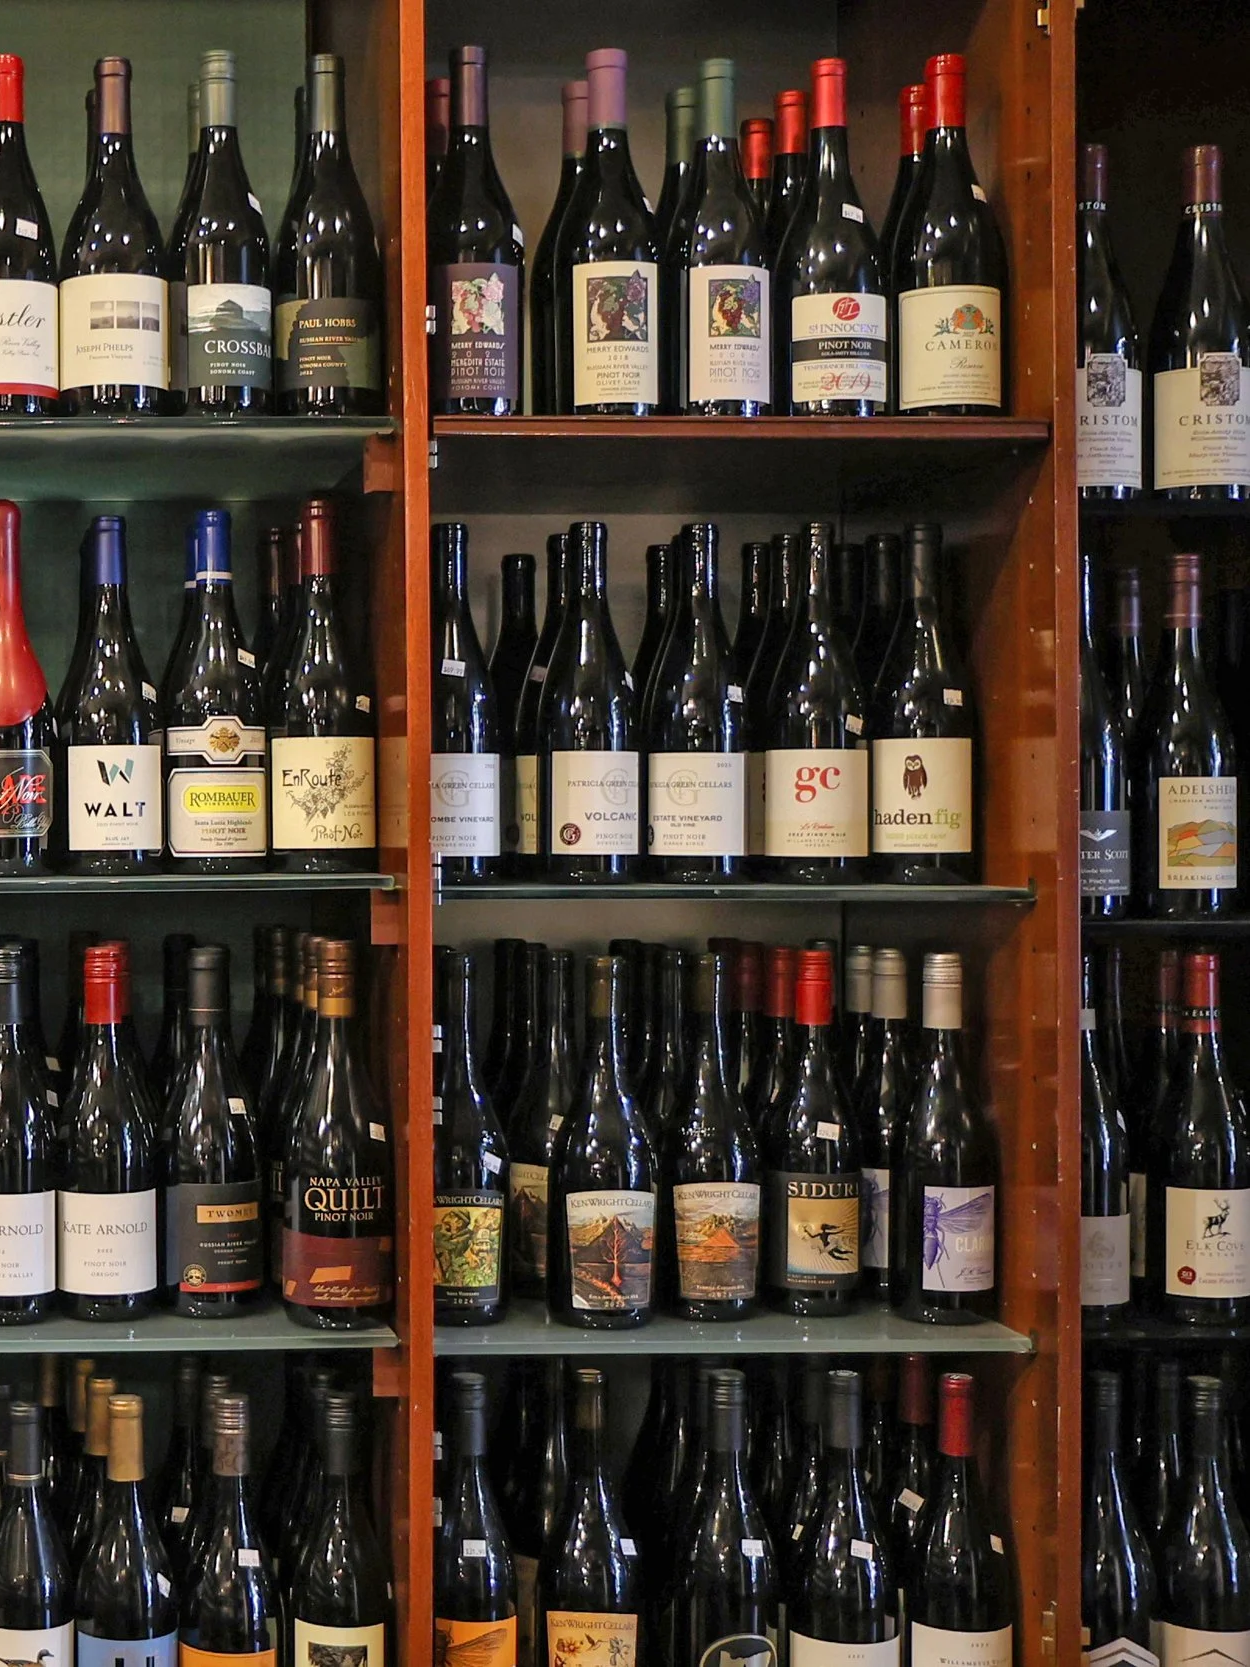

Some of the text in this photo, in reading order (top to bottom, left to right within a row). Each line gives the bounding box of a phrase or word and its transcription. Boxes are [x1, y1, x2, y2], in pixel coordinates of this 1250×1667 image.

[299, 318, 358, 329] PAUL HOBBS
[819, 322, 879, 336] INNOCENT
[75, 343, 134, 356] JOSEPH PHELPS
[586, 346, 649, 354] MERRY EDWARDS
[818, 341, 872, 350] PINOT NOIR
[450, 358, 483, 367] MEREDITH
[450, 366, 505, 377] PINOT NOIR
[709, 367, 737, 378] PINOT
[1079, 413, 1138, 427] RISTOM
[281, 768, 342, 789] EnRoute
[698, 780, 733, 788] CELLARS
[794, 766, 841, 804] gc
[189, 791, 256, 808] ROMBAUER
[84, 801, 146, 818] WALT
[874, 808, 932, 825] haden
[201, 827, 226, 835] PINOT
[310, 823, 364, 842] Pinot Noir
[309, 1176, 341, 1187] NAPA
[304, 1186, 385, 1212] QUILT
[678, 1190, 731, 1199] KEN WRIGHT
[570, 1199, 624, 1208] KEN WRIGHT
[314, 1212, 374, 1222] PINOT NOIR
[63, 1221, 148, 1236] KATE ARNOLD
[956, 1235, 986, 1252] CLAR
[1186, 1240, 1245, 1251] ELK COVE
[565, 1619, 604, 1630] WRIGHT
